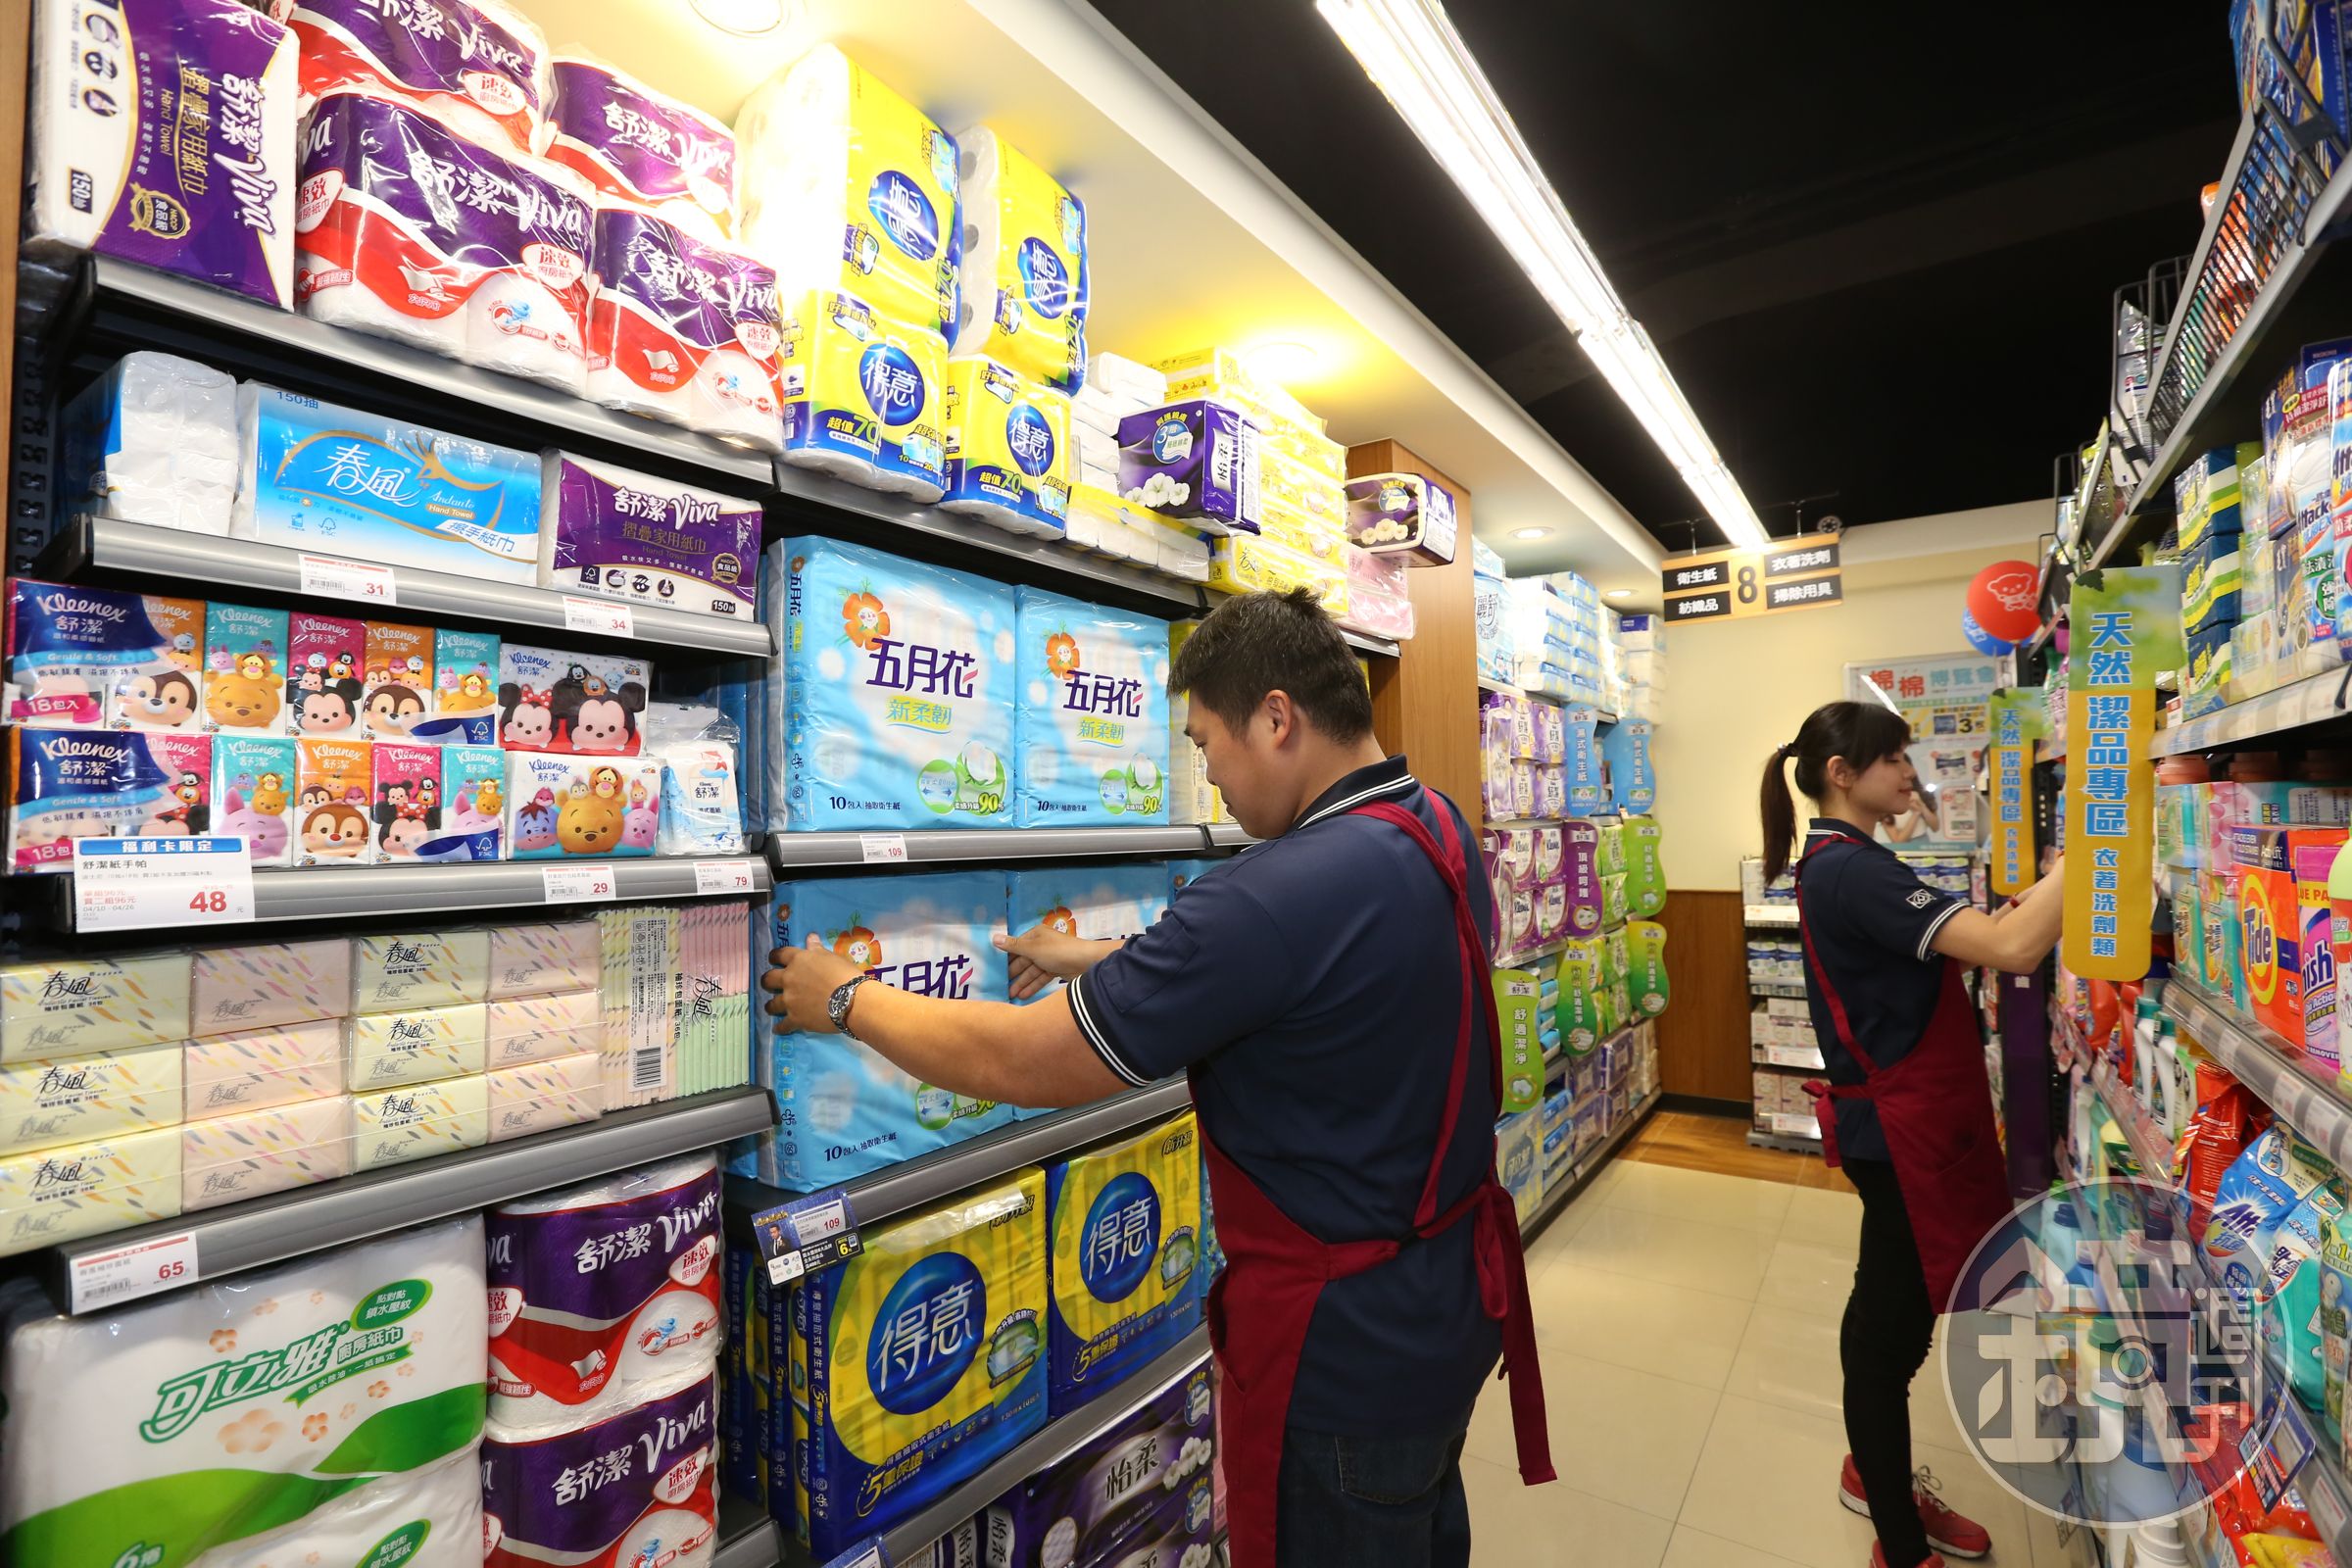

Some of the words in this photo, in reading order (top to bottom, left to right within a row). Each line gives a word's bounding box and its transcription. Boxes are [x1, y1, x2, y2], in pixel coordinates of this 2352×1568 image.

[160, 88, 174, 121] Hand
[220, 73, 265, 154] 舒潔
[181, 67, 212, 196] 摺疊家用紙巾
[602, 101, 672, 157] 舒潔
[160, 124, 174, 157] Towel
[214, 152, 277, 236] Viva
[154, 197, 171, 232] 食品級
[513, 180, 583, 234] Viva
[720, 272, 779, 318] Viva
[863, 357, 918, 410] 得意
[276, 391, 319, 410] 150抽
[1008, 416, 1052, 462] 得意
[314, 443, 422, 508] 春風
[428, 504, 451, 515] Hand
[452, 507, 473, 519] Towel
[612, 487, 668, 522] 舒潔
[669, 494, 718, 530] Viva
[446, 520, 515, 554] 擦手紙巾
[621, 520, 708, 554] 摺疊家用紙巾
[642, 546, 664, 557] Hand
[1772, 549, 1831, 570] 衣著洗劑
[717, 564, 738, 573] 食品級
[1677, 567, 1718, 586] 衛生紙
[367, 582, 385, 596] 31
[789, 573, 803, 616] 五月花
[1738, 566, 1758, 604] 8
[1774, 582, 1833, 603] 掃除用具
[36, 592, 128, 622] Kleenex
[1679, 598, 1719, 614] 紡織品
[55, 615, 104, 634] 舒潔
[217, 608, 273, 628] Kleenex
[298, 618, 351, 638] Kleenex
[612, 619, 626, 630] 34
[228, 623, 260, 636] 舒潔
[310, 633, 337, 645] 舒潔
[373, 627, 422, 645] Kleenex
[383, 641, 409, 652] 舒潔
[444, 635, 488, 652] Kleenex
[454, 648, 478, 660] 舒潔
[47, 653, 81, 662] Gentle
[96, 653, 119, 662] Soft
[509, 651, 551, 669] Kleenex
[865, 637, 979, 699] 五月花
[517, 665, 540, 676] 舒潔
[1063, 669, 1144, 717] 五月花
[27, 698, 80, 713] 18包入
[886, 699, 953, 726] 新柔韌
[1077, 720, 1124, 742] 新柔韌
[1959, 718, 1973, 733] 3
[39, 736, 131, 763] Kleenex
[227, 741, 284, 760] Kleenex
[312, 745, 364, 761] Kleenex
[388, 748, 434, 764] Kleenex
[456, 751, 499, 766] Kleenex
[59, 760, 107, 777] 舒潔
[239, 756, 270, 767] 舒潔
[322, 760, 351, 771] 舒潔
[397, 762, 423, 773] 舒潔
[466, 762, 489, 773] 舒潔
[529, 759, 572, 774] Kleenex
[537, 773, 561, 783] 舒潔
[52, 795, 86, 806] Gentle
[101, 794, 122, 805] Soft
[695, 787, 720, 800] 舒潔
[830, 796, 862, 809] 10包入
[864, 800, 901, 810] 抽取衛生紙
[122, 840, 213, 853] 福利卡限定
[887, 848, 902, 858] 109
[82, 860, 147, 870] 舒潔紙手帕
[1578, 852, 1589, 899] 頂級呵護
[593, 883, 609, 894] 29
[735, 876, 748, 887] 79
[189, 891, 227, 913] 48
[2092, 848, 2118, 957] 衣著洗劑類
[2244, 907, 2273, 974] Tide
[383, 942, 425, 964] 春風
[40, 970, 100, 999] 春風
[1510, 985, 1531, 996] 舒潔
[692, 972, 722, 1028] 春風
[388, 1018, 430, 1041] 春風
[1514, 1008, 1527, 1065] 舒適潔淨
[36, 1065, 99, 1094] 春風
[377, 1094, 421, 1118] 春風
[824, 1143, 859, 1162] 10包入
[1162, 1130, 1194, 1157] 新升級
[30, 1158, 93, 1188] 春風
[824, 1217, 840, 1231] 109
[573, 1223, 654, 1274] 舒潔
[840, 1243, 850, 1255] 6
[1084, 1196, 1153, 1281] 得意
[683, 1242, 710, 1267] 速效
[159, 1260, 184, 1280] 65
[375, 1290, 407, 1305] 點對點
[366, 1299, 413, 1320] 鎖水壓紋
[337, 1326, 404, 1364] 廚房紙巾
[812, 1290, 823, 1381] 得意抽取式衛生紙
[871, 1279, 975, 1393] 得意
[308, 1370, 347, 1395] 吸水除油
[354, 1351, 397, 1371] 一紙搞定
[139, 1326, 343, 1445] 可立雅
[551, 1445, 633, 1506] 舒潔
[638, 1399, 707, 1474] Viva
[668, 1457, 698, 1485] 速效
[1105, 1436, 1160, 1501] 怡柔
[378, 1535, 409, 1555] 點對點
[992, 1516, 1007, 1563] 怡柔
